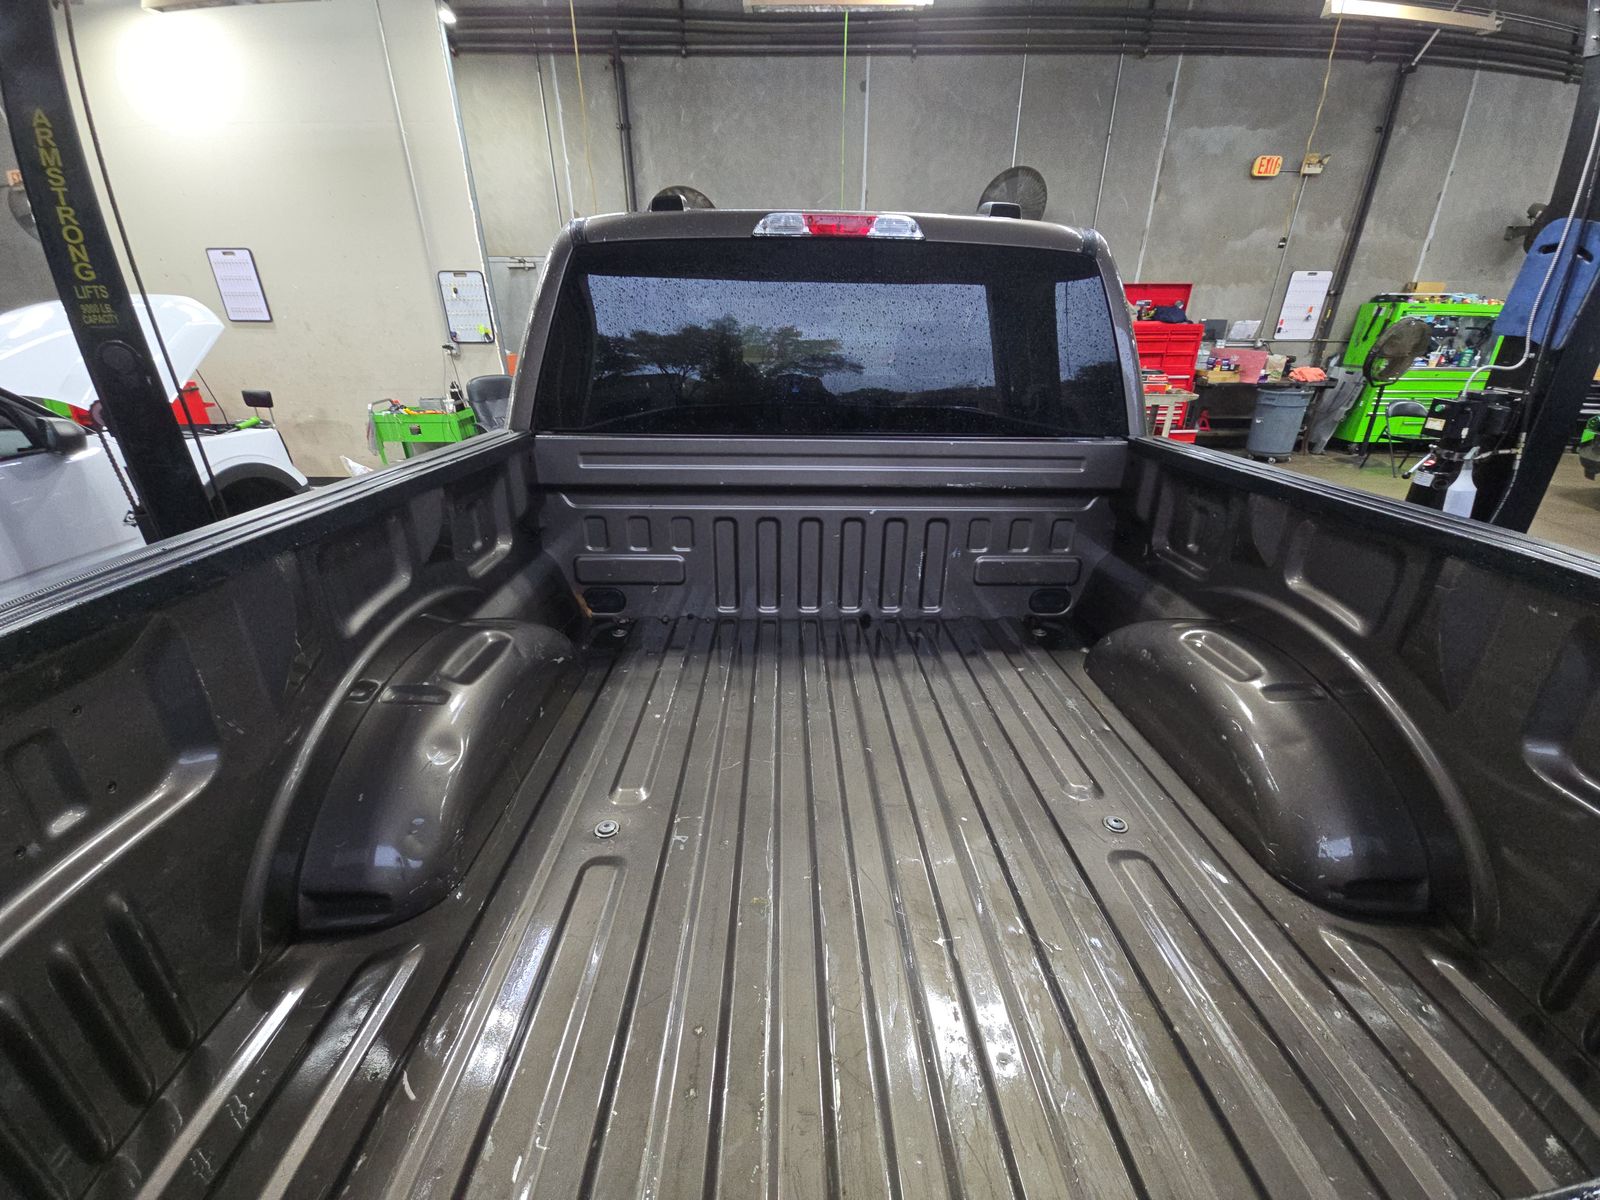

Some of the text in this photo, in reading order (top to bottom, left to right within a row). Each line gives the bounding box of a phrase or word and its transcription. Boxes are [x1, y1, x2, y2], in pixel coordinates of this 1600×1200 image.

[1257, 157, 1280, 175] EXIT
[32, 108, 96, 282] ARMSTRONG
[74, 285, 109, 299] LIFTS
